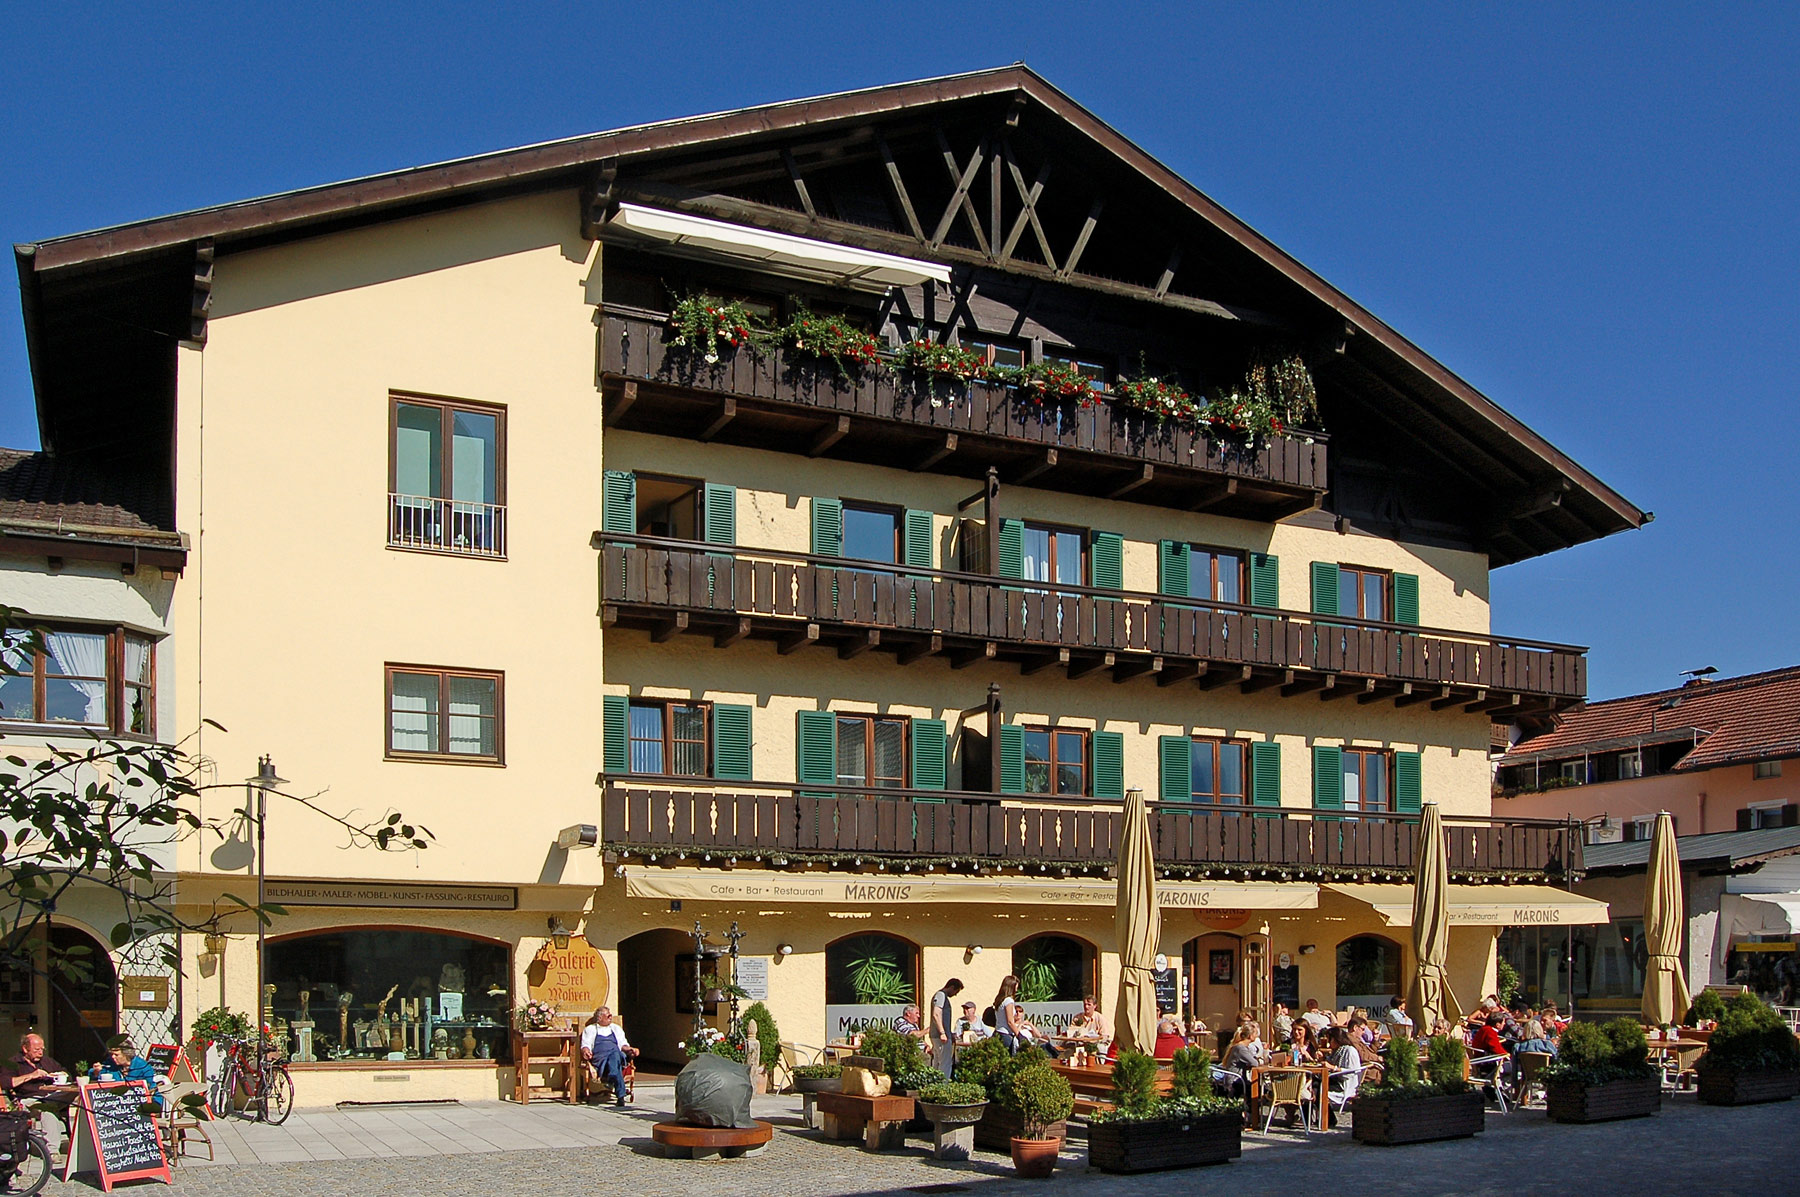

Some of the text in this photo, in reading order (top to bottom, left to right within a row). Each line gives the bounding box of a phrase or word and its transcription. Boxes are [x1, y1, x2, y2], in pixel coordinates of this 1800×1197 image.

[267, 888, 317, 897] BILDHAUER
[322, 890, 352, 898] MALER
[393, 892, 420, 900] KUNST
[425, 892, 463, 901] FASSUNG
[467, 893, 509, 902] RESTAURO
[710, 884, 911, 900] Cafe Bar Restaurant MARONIS
[1040, 891, 1061, 899] Cafe
[1070, 891, 1085, 899] Bar
[1092, 892, 1117, 900] Resta
[1463, 912, 1498, 921] Restaurant
[1513, 909, 1560, 923] MARONIS
[547, 949, 596, 970] Galerie
[556, 971, 584, 986] Drei
[548, 987, 591, 1003] Mohren
[839, 1016, 902, 1032] MARONI
[1024, 1013, 1073, 1028] MARONI
